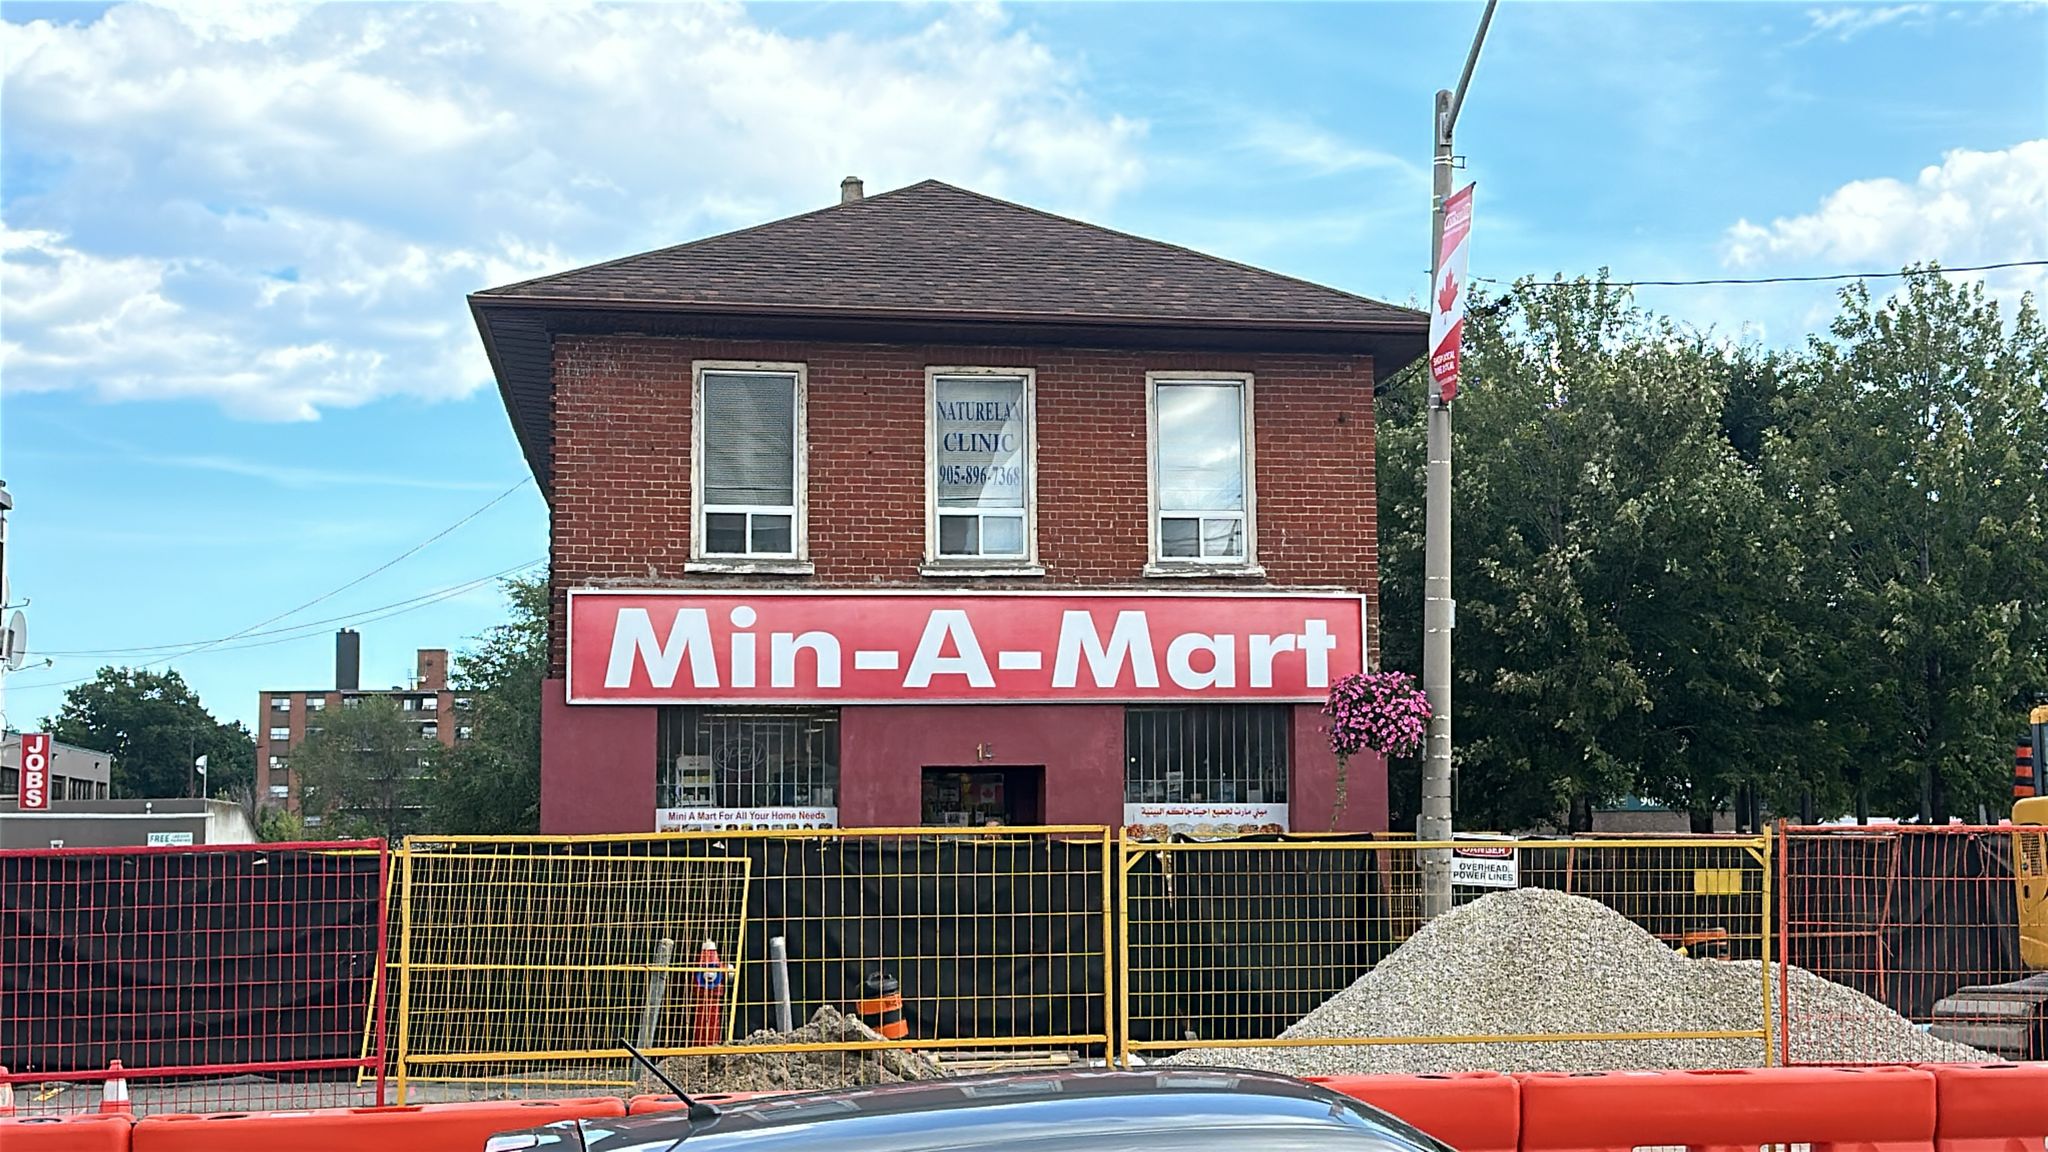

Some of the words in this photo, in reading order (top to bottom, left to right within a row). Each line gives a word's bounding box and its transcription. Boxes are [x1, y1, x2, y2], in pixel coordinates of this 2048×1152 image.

[944, 432, 1014, 453] CLINIC
[939, 465, 1021, 486] 905-896-7368
[603, 605, 1337, 690] Min-A-Mart
[25, 736, 45, 807] JOBS
[668, 811, 687, 821] Mini
[688, 811, 696, 821] A
[697, 811, 717, 821] Mart
[719, 811, 733, 820] For
[735, 810, 748, 820] All
[749, 811, 770, 821] Your
[771, 811, 797, 820] Home
[798, 811, 826, 820] Needs
[150, 834, 170, 843] FREE
[1459, 862, 1508, 872] OVERHEAD
[1453, 870, 1486, 880] POWER
[1488, 873, 1514, 881] LINES
